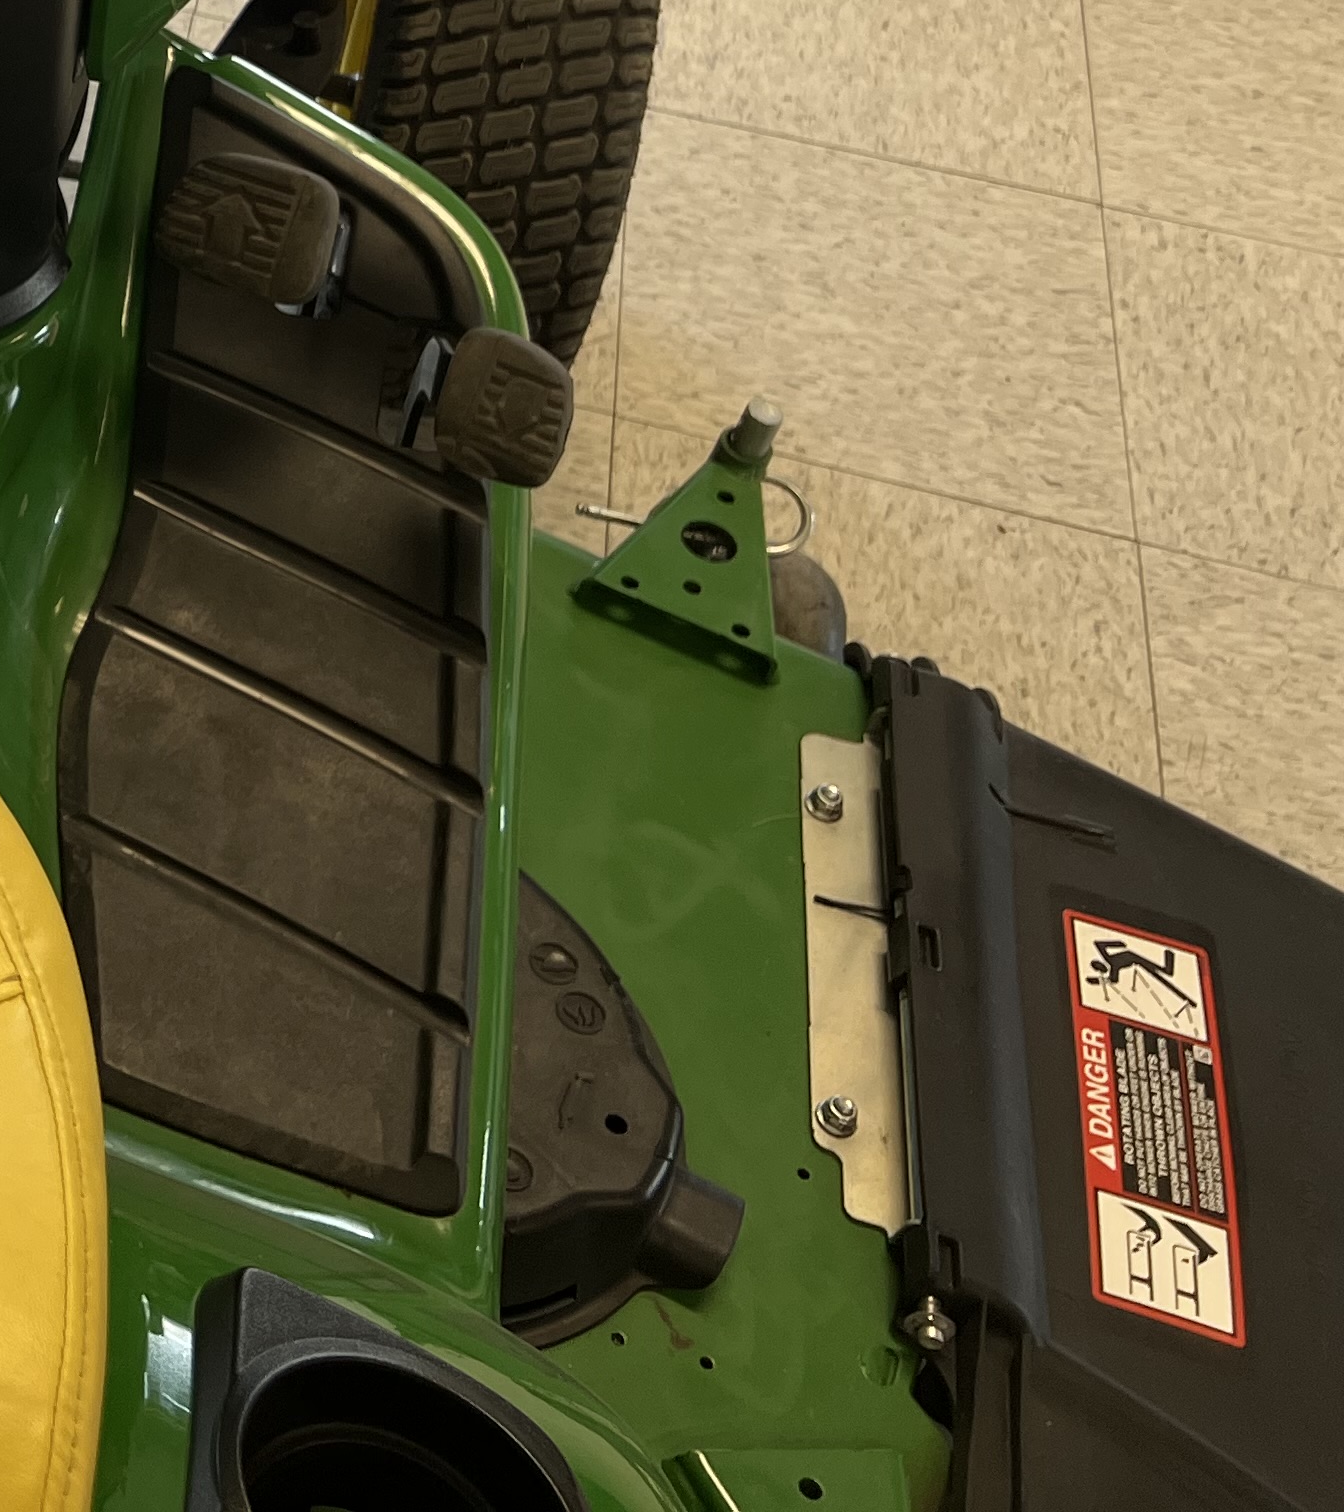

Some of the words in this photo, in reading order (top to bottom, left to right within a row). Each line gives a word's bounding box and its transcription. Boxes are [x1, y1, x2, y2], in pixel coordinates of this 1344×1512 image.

[1082, 1029, 1113, 1138] DANGER
[1115, 1049, 1129, 1093] BLADE
[1148, 1055, 1162, 1116] OBJECTS
[1120, 1096, 1134, 1164] ROTATING
[1155, 1118, 1168, 1176] THROWN
